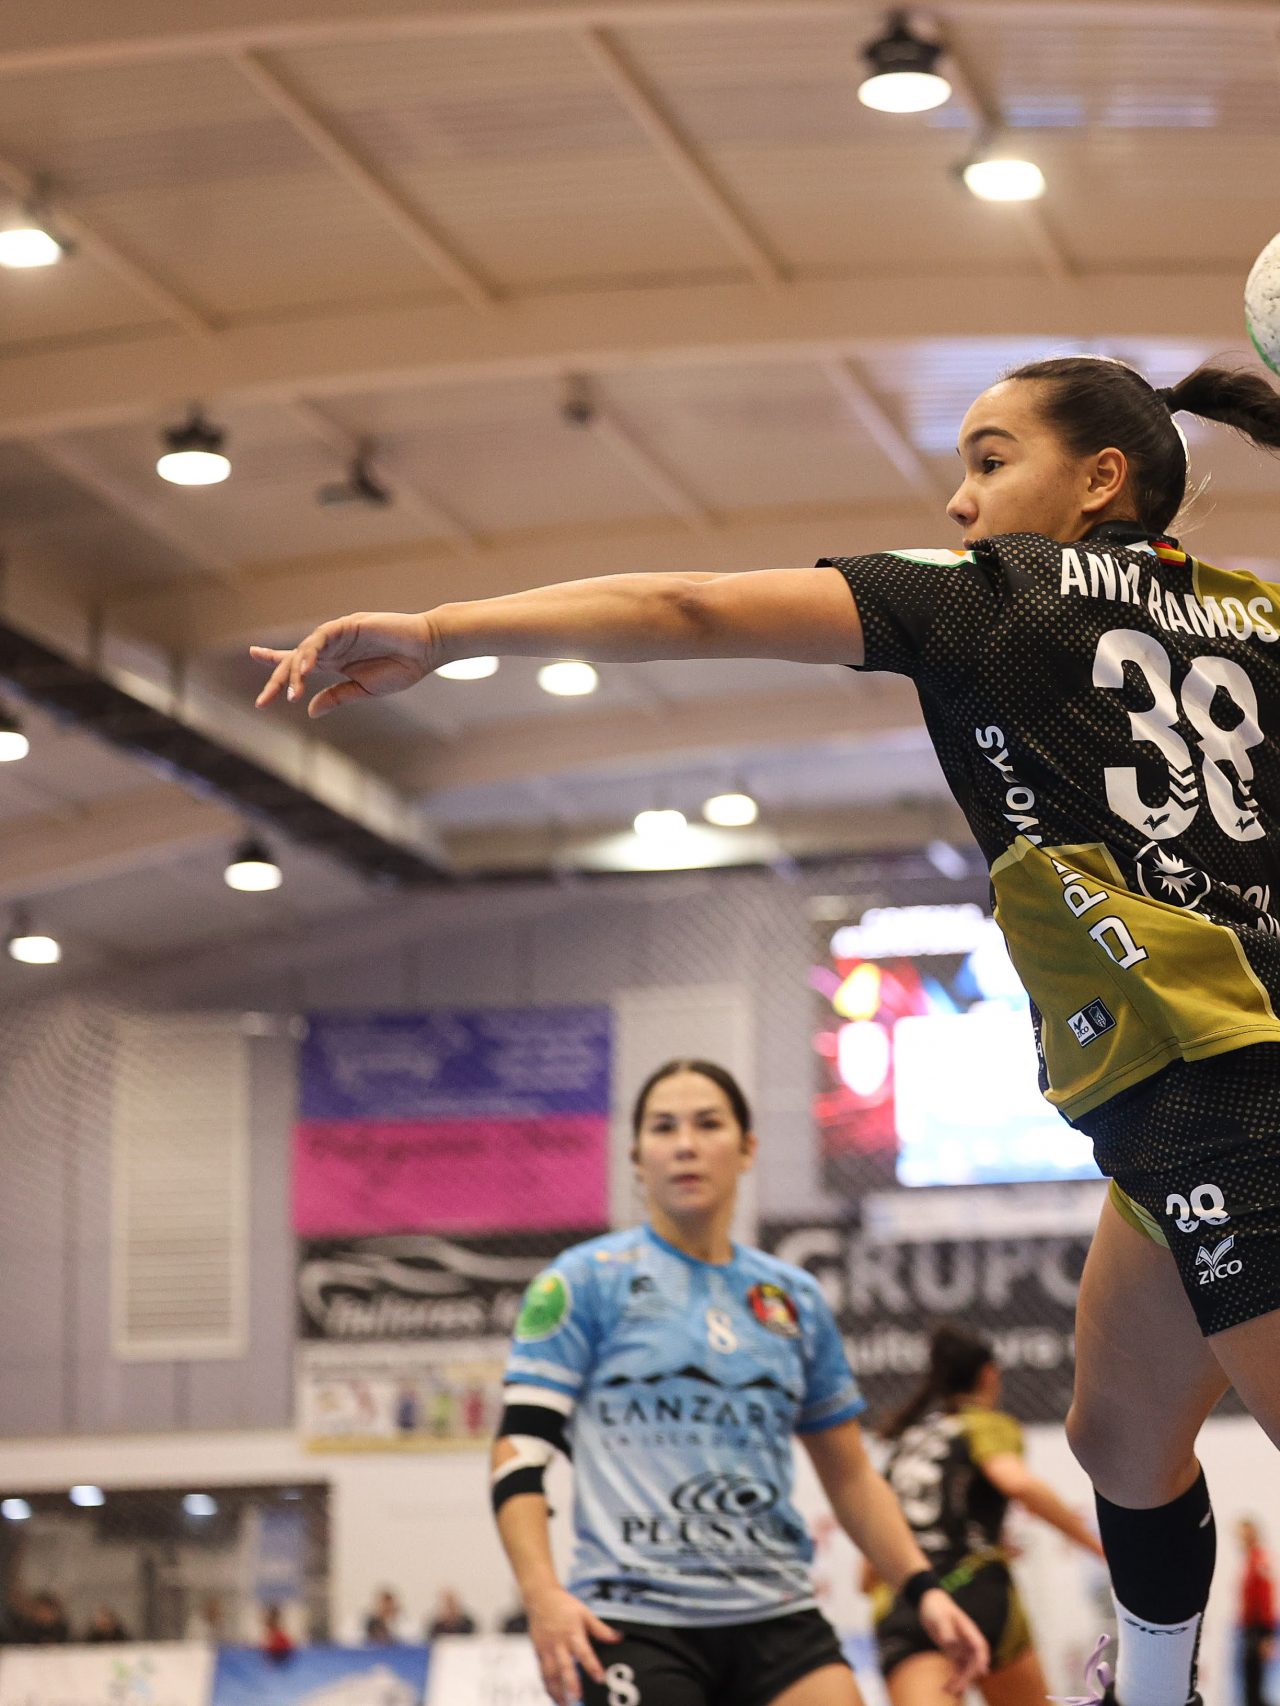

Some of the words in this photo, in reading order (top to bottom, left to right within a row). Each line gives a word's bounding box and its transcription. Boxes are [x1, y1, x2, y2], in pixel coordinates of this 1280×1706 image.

[1148, 576, 1279, 643] RAMOS
[1092, 628, 1266, 842] 38
[1198, 1260, 1243, 1285] ZICO
[706, 1306, 738, 1353] 8
[606, 1662, 641, 1706] 8
